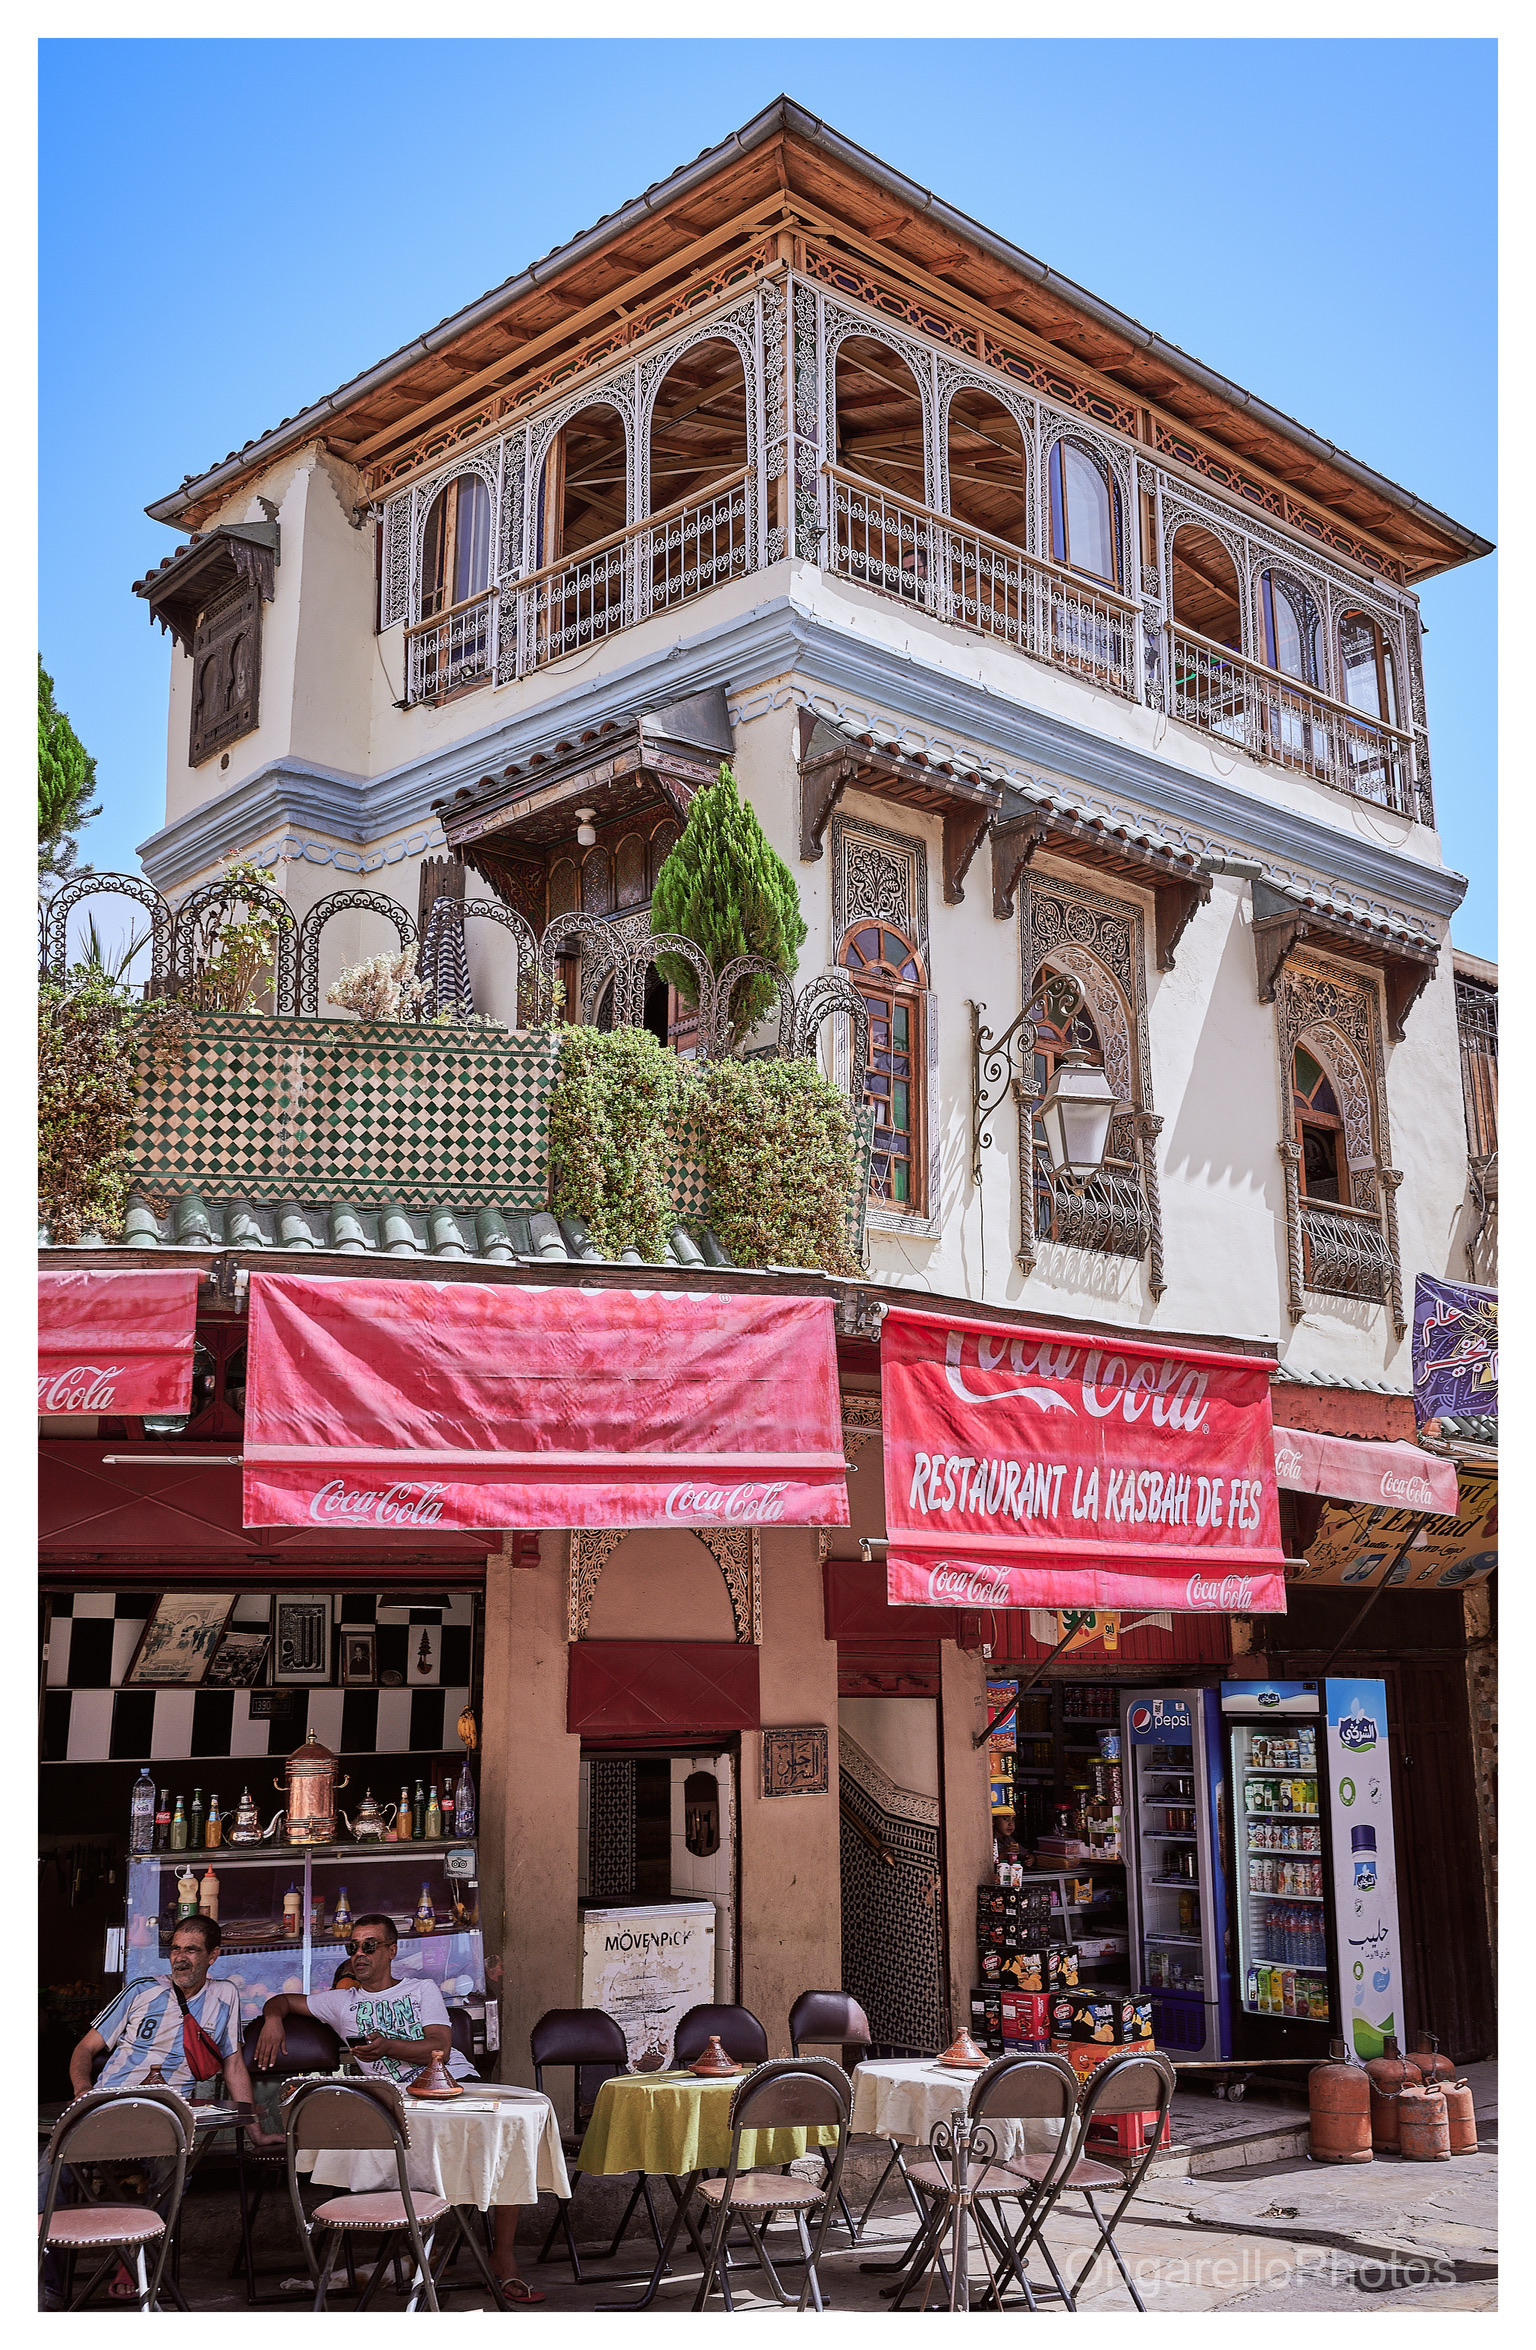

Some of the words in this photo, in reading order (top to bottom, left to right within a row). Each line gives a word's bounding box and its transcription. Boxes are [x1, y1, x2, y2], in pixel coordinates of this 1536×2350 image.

[309, 1479, 451, 1525] Coca-Cola
[665, 1481, 790, 1521] Coca-Cola
[909, 1452, 1067, 1521] RESTAURANT
[1073, 1465, 1099, 1523] LA
[1104, 1467, 1191, 1526] KASBAH
[1197, 1475, 1224, 1528] DE
[1229, 1478, 1263, 1530] FES
[1380, 1470, 1432, 1505] Coca-Cola
[928, 1562, 1011, 1604] Coca-Cola
[1185, 1573, 1252, 1608] Coca-Cola
[1154, 1713, 1191, 1729] pepsi
[1348, 1918, 1389, 1951] حليب
[356, 1997, 415, 2037] RUN
